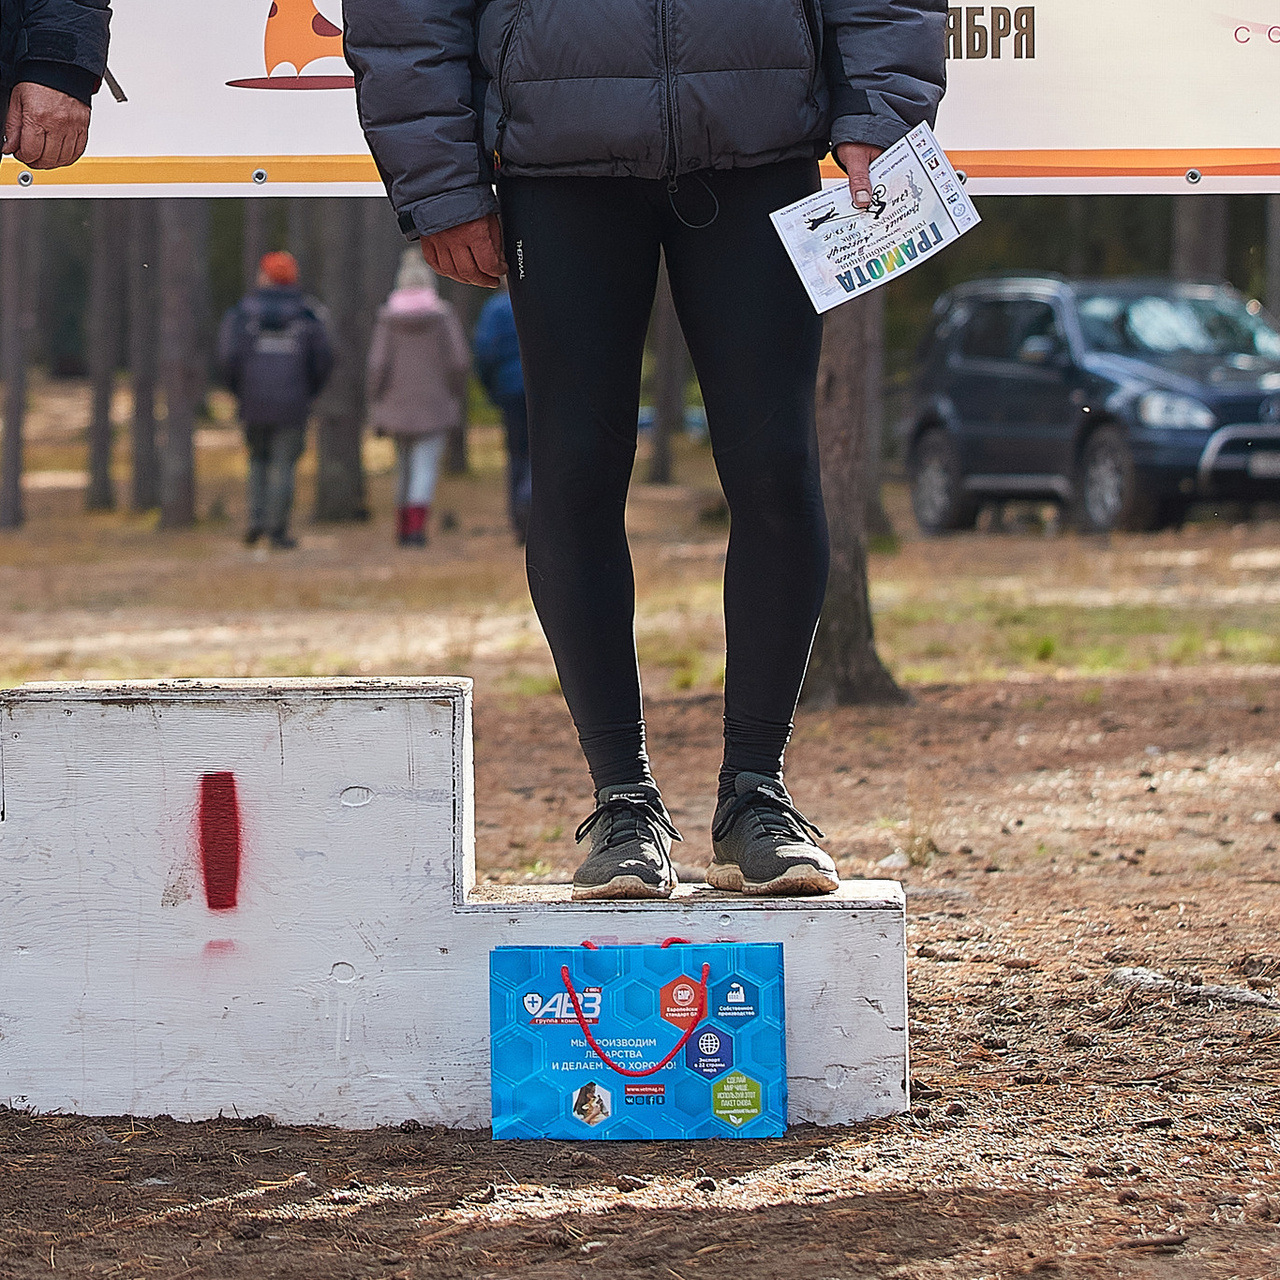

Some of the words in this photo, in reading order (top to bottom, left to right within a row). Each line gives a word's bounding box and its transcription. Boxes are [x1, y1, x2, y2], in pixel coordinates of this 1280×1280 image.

[945, 6, 1036, 59] ЯБРЯ
[835, 222, 944, 294] ГРАМОТА
[552, 1062, 559, 1070] И
[561, 1062, 603, 1072] ДЕЛАЕМ
